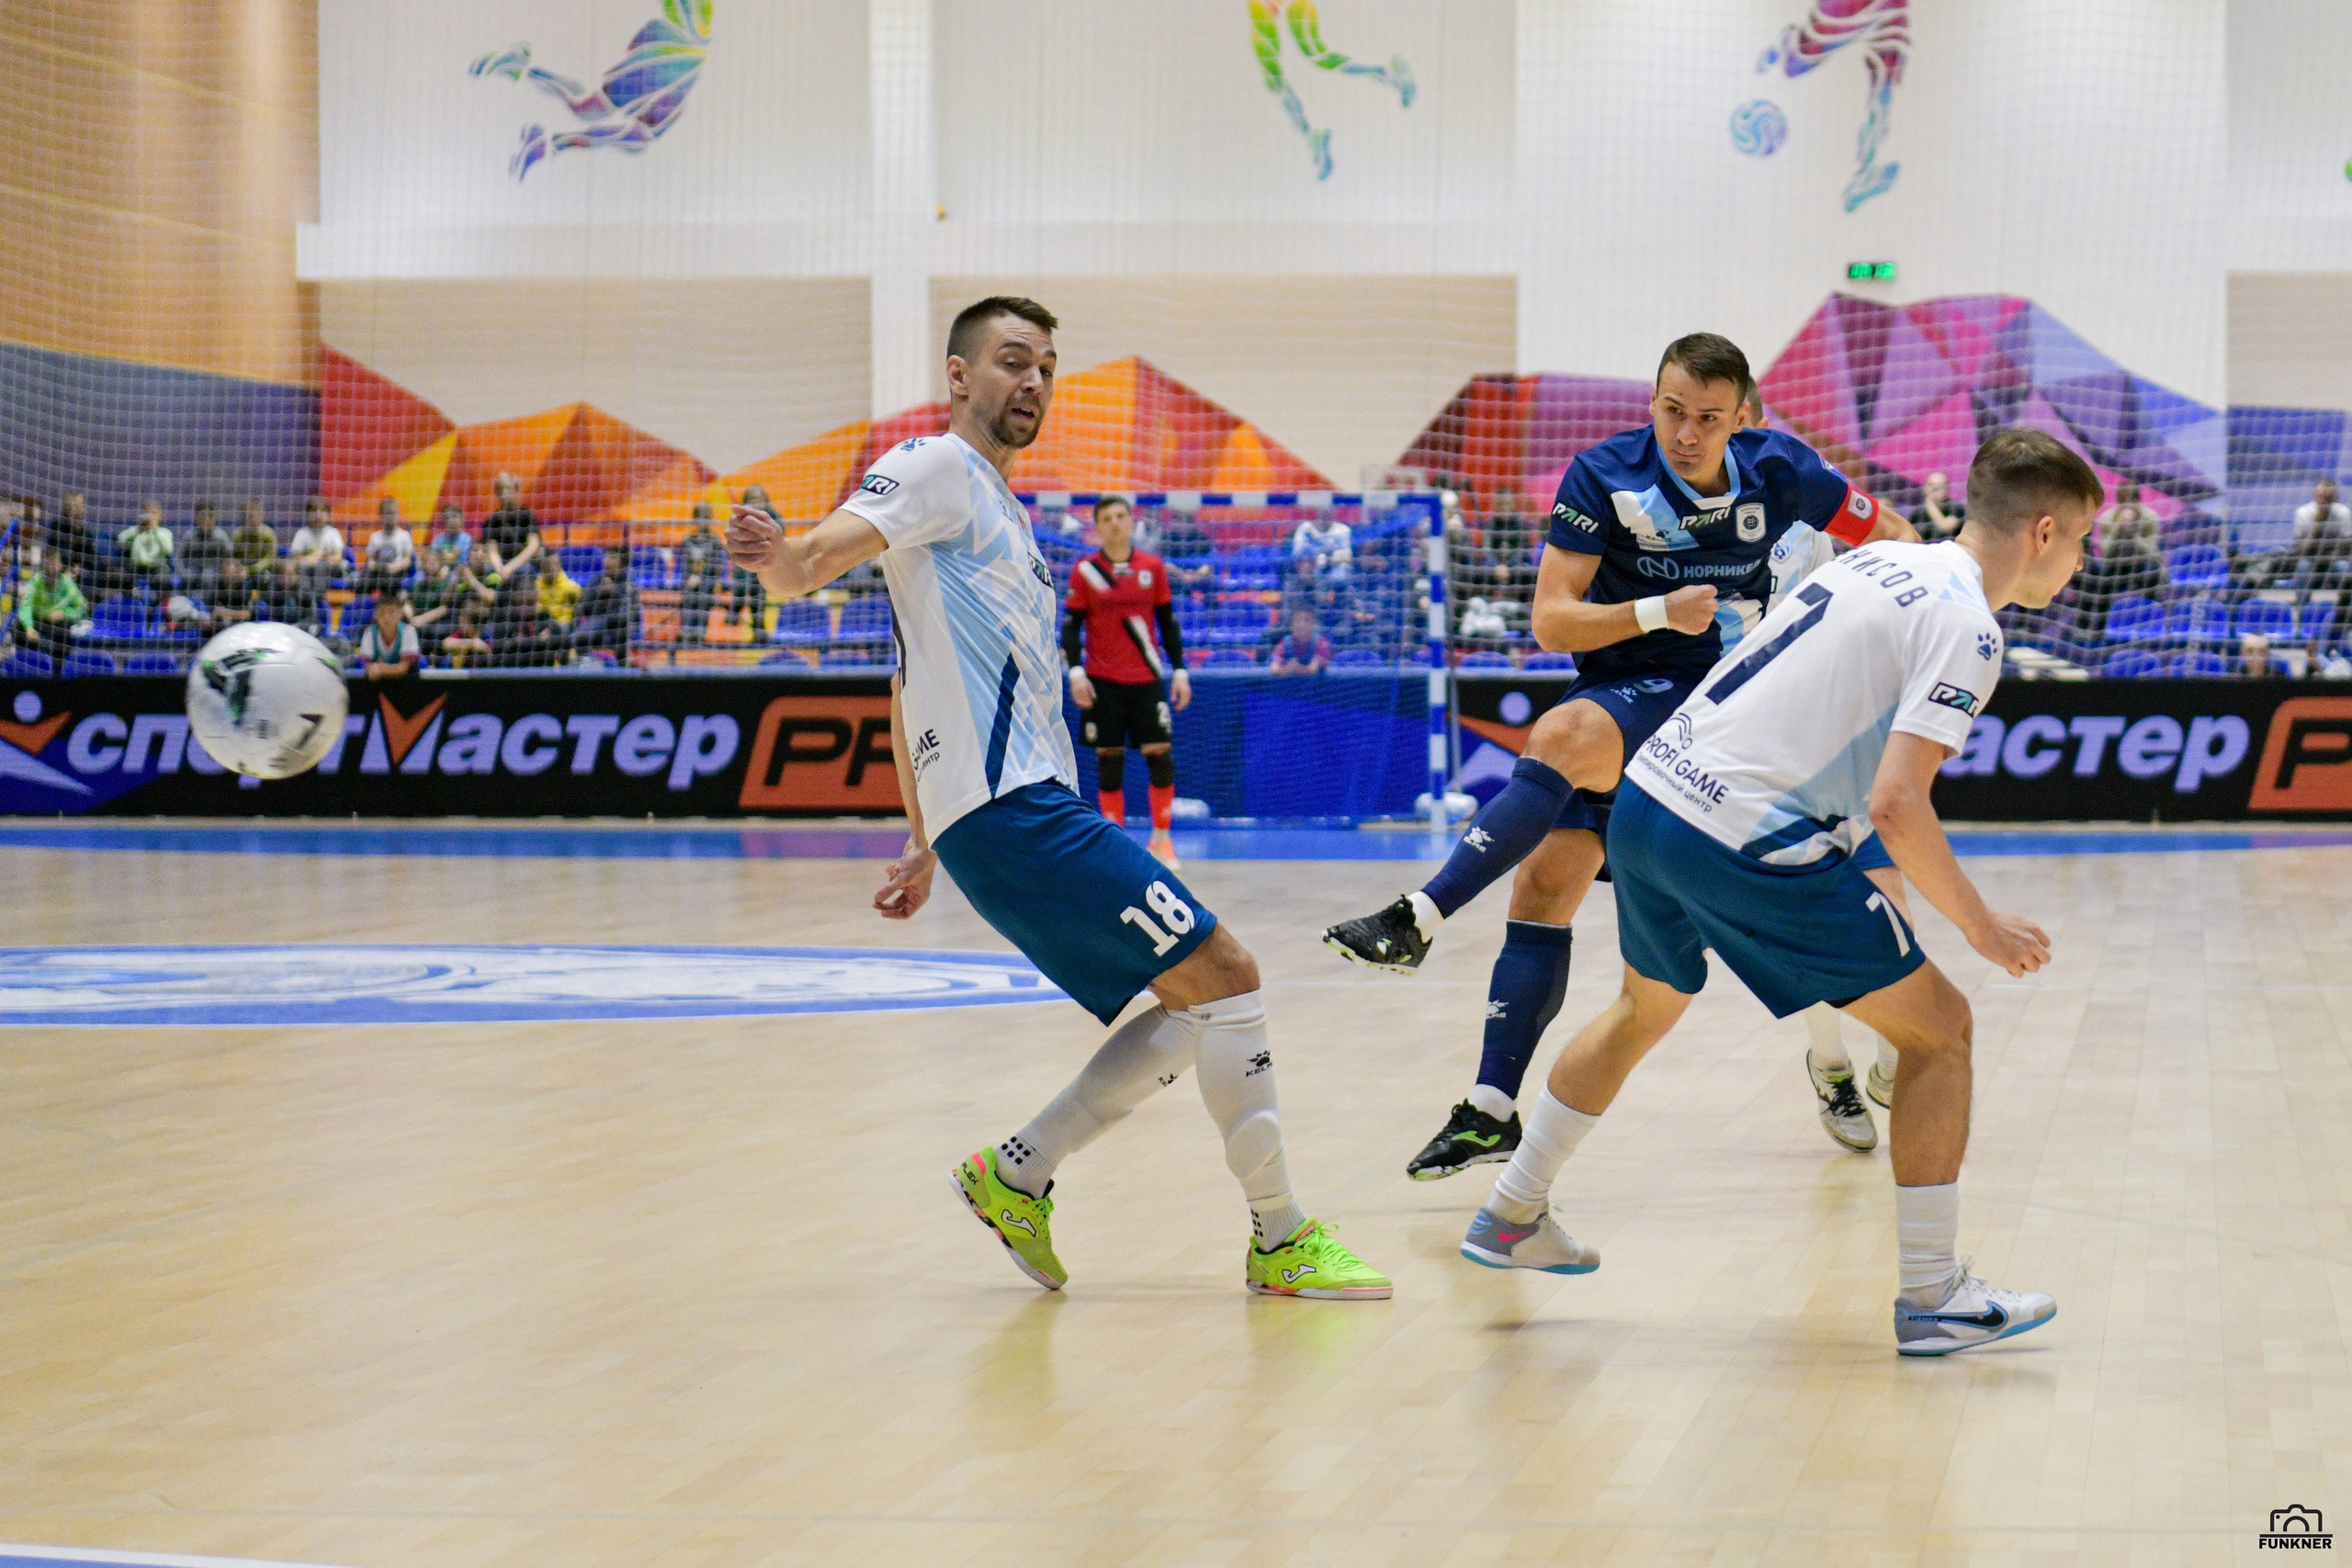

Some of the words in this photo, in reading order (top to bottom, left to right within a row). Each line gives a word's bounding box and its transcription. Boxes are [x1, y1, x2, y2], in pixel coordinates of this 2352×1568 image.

[1552, 502, 1599, 534] PARI
[1679, 506, 1731, 530] PARI
[1704, 581, 1834, 705] 7
[1633, 679, 1674, 694] 9
[67, 693, 741, 791] сптМастер
[1675, 760, 1729, 805] GAME
[1684, 791, 1713, 812] центр
[1120, 880, 1195, 957] 18
[1865, 891, 1910, 957] 7
